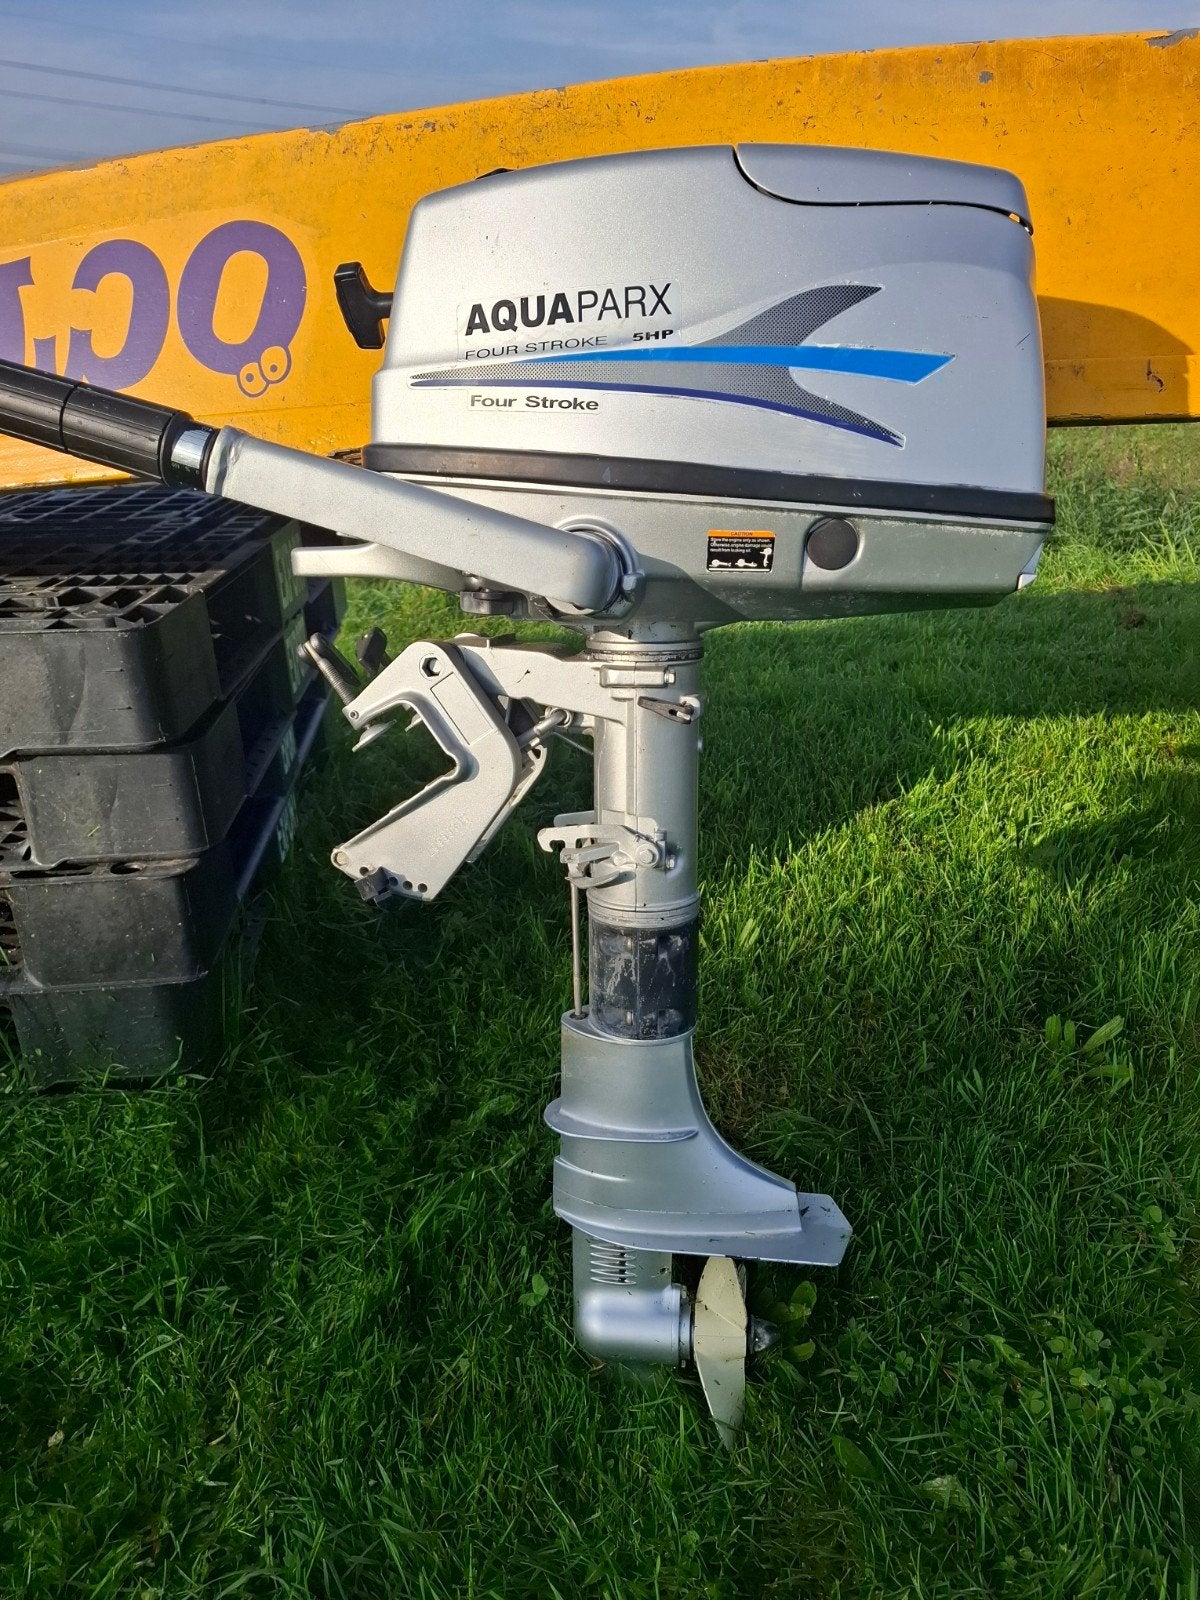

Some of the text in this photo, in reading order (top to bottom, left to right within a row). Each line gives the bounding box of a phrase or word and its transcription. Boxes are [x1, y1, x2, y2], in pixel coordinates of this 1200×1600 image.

[465, 282, 672, 336] AQUAPARX
[465, 329, 674, 360] FOUR STROKE 5HP
[470, 394, 599, 411] Four Stroke
